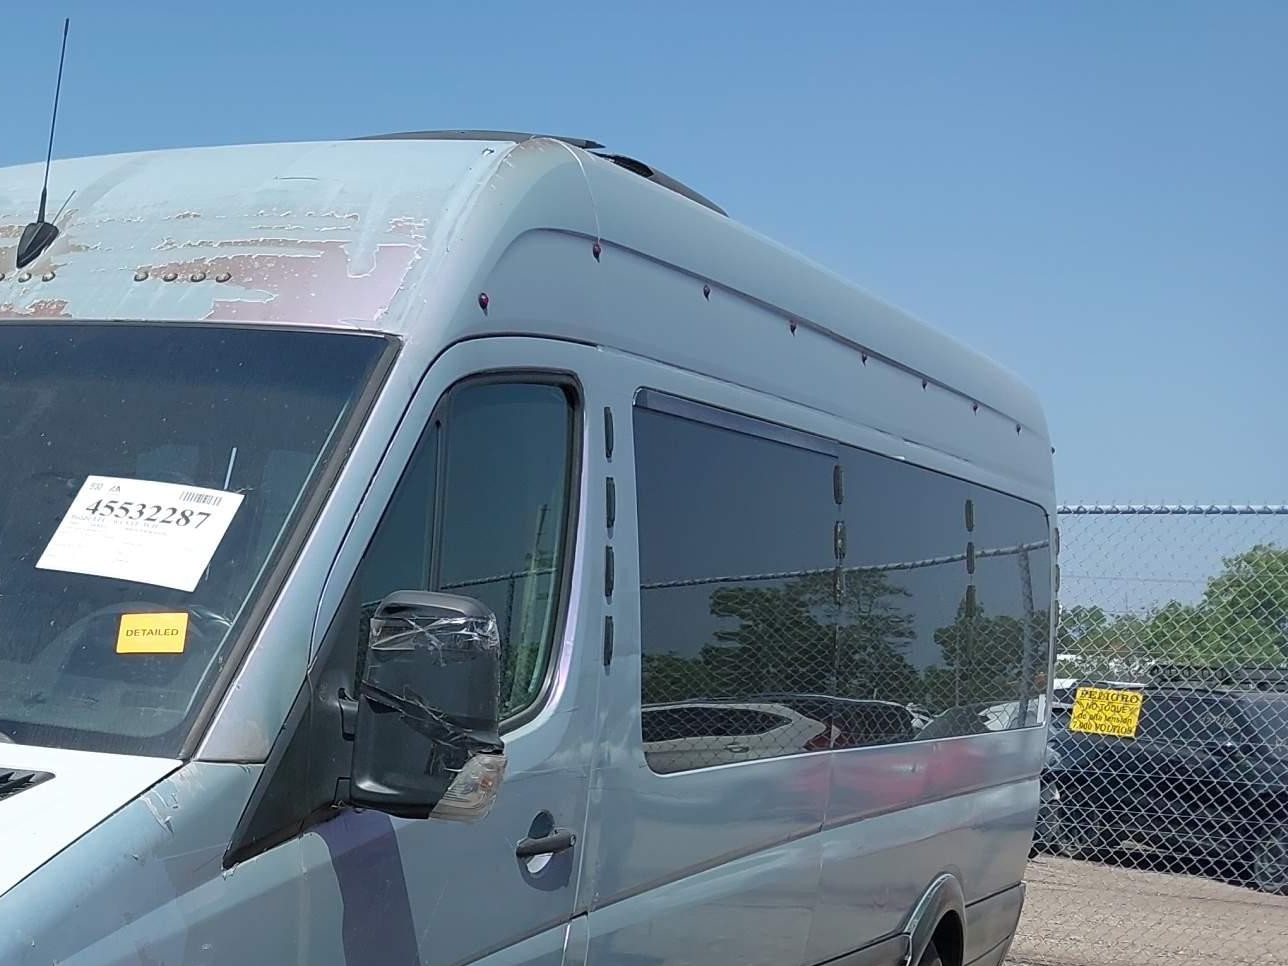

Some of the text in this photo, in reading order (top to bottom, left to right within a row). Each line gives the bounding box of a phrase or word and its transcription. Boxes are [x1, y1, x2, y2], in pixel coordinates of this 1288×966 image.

[85, 497, 212, 529] 45532287
[125, 628, 180, 637] DETAILED
[1084, 703, 1128, 714] NO TOQUE
[1078, 712, 1087, 720] de
